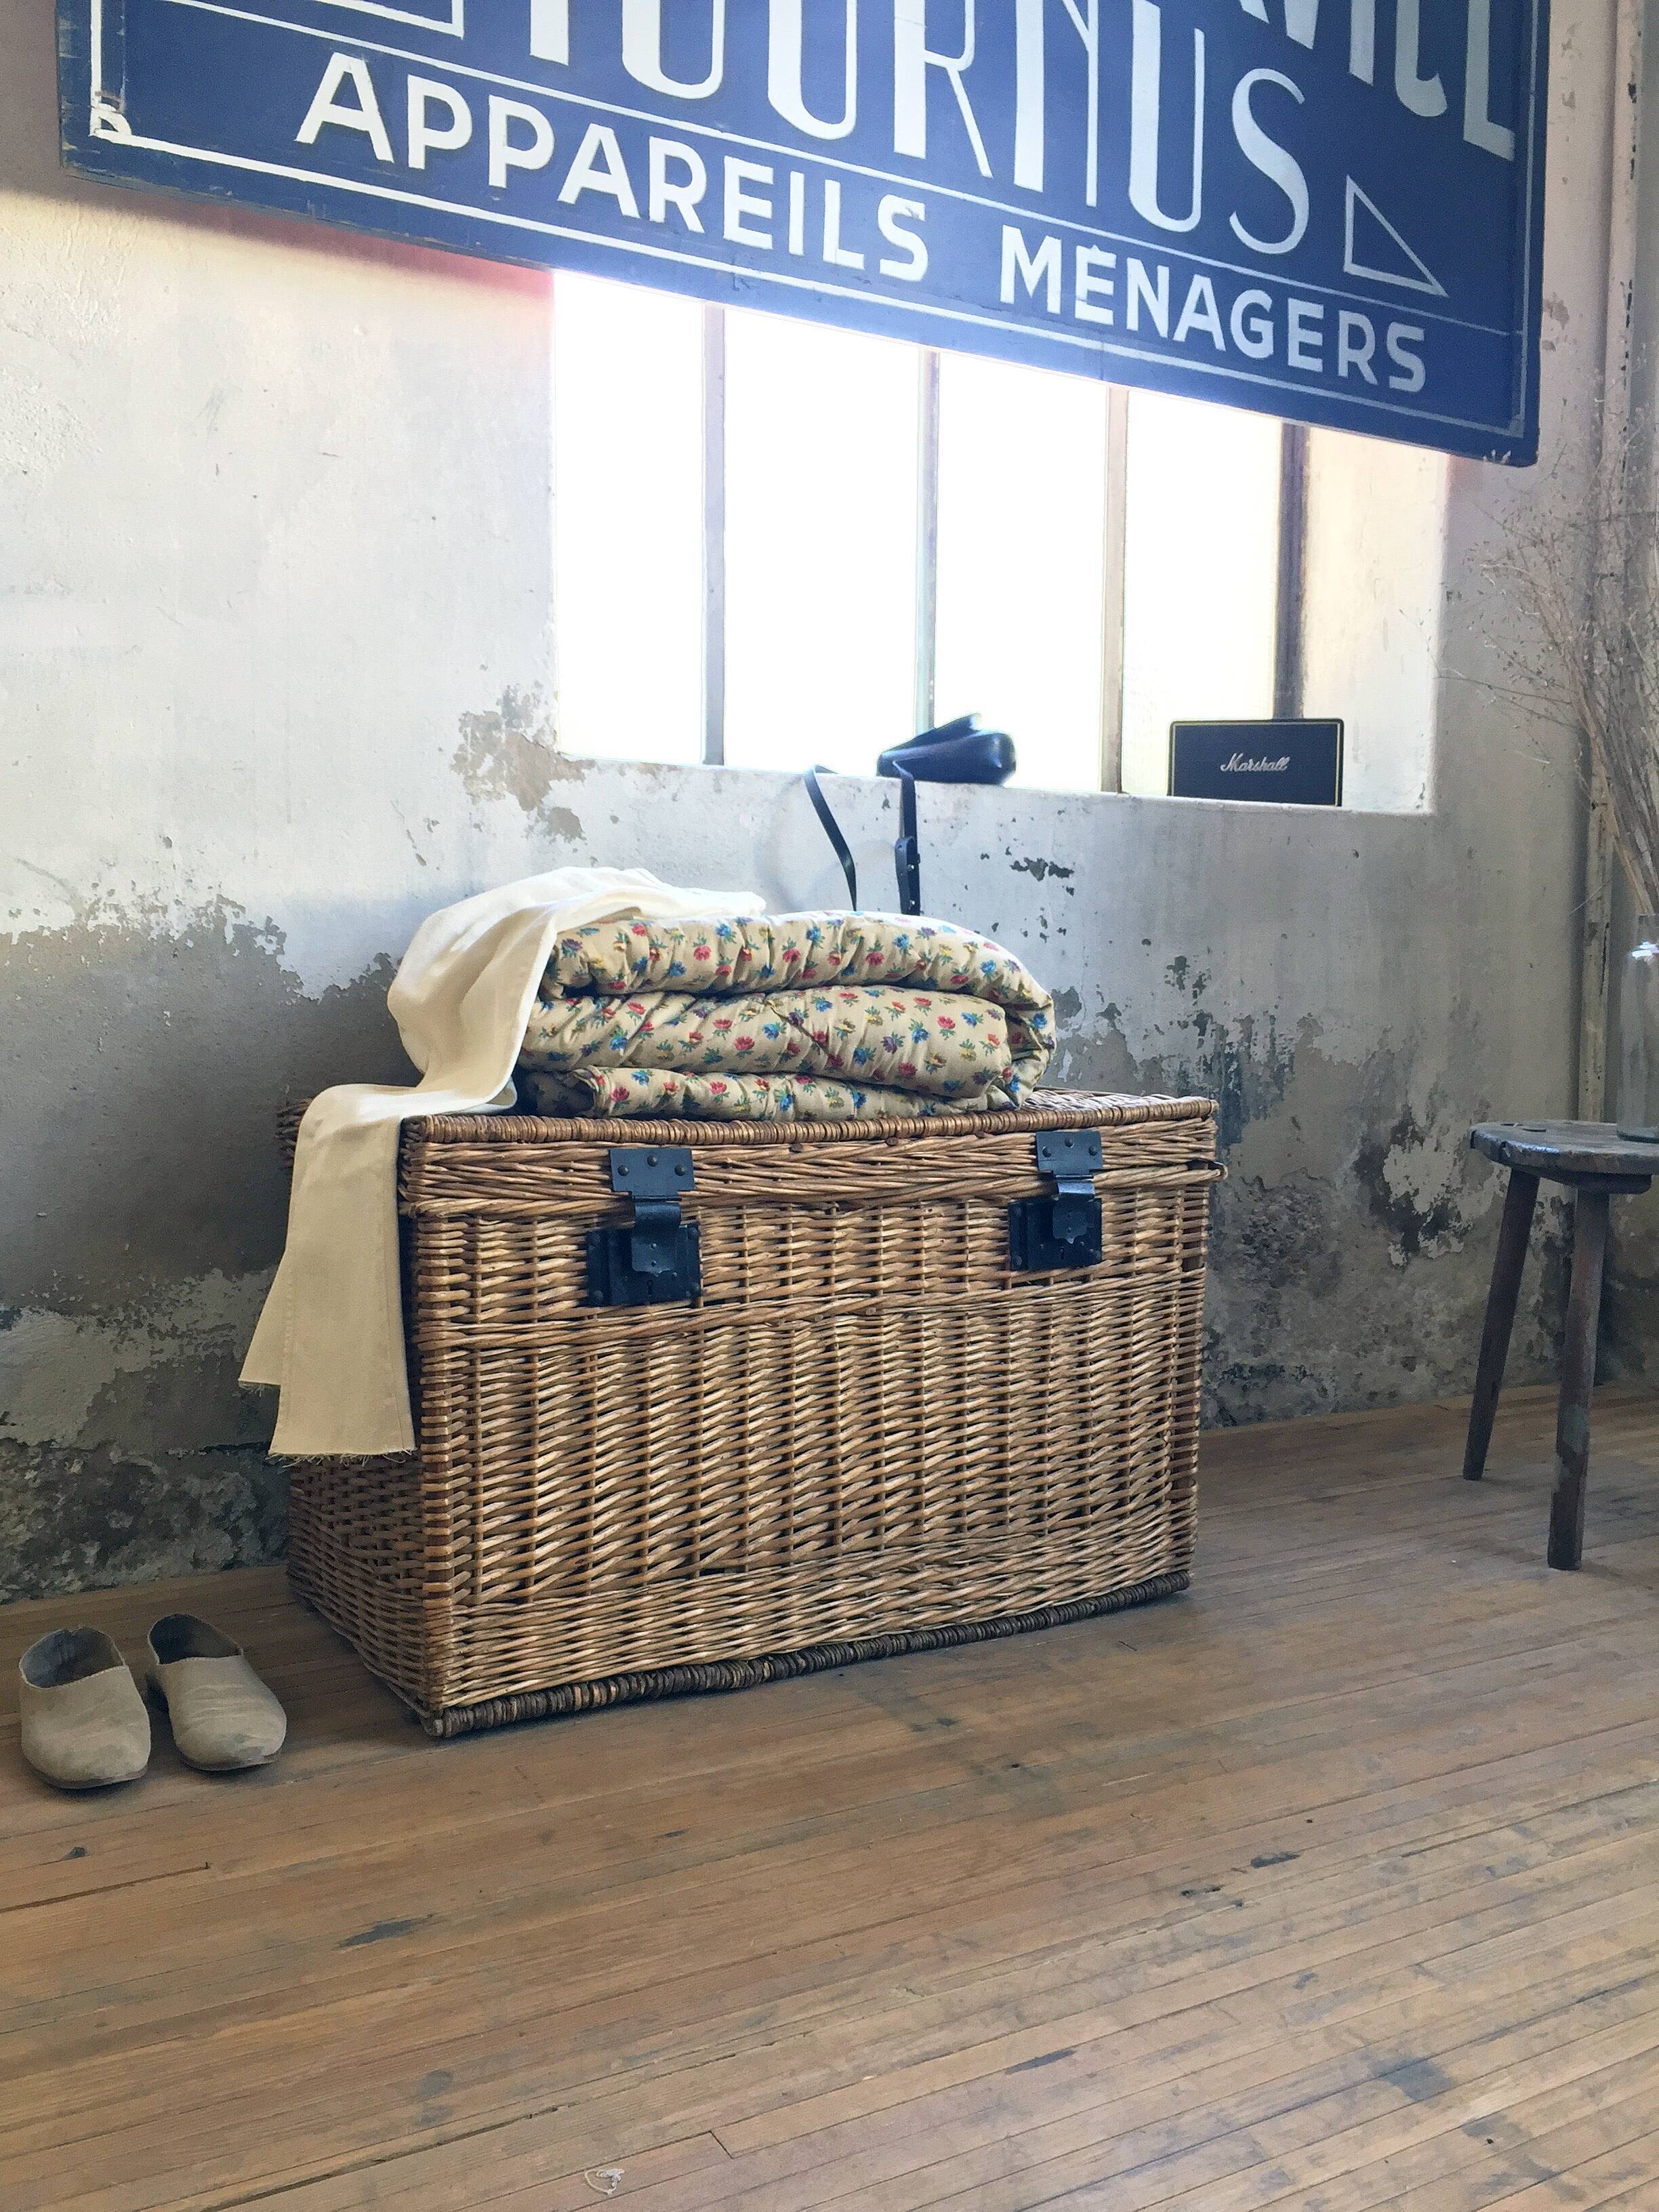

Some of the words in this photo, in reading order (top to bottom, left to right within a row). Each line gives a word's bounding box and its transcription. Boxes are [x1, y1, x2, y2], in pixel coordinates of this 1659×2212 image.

[295, 52, 929, 282] APPAREILS
[528, 0, 1309, 253] RNUS
[1221, 752, 1290, 772] Marshall
